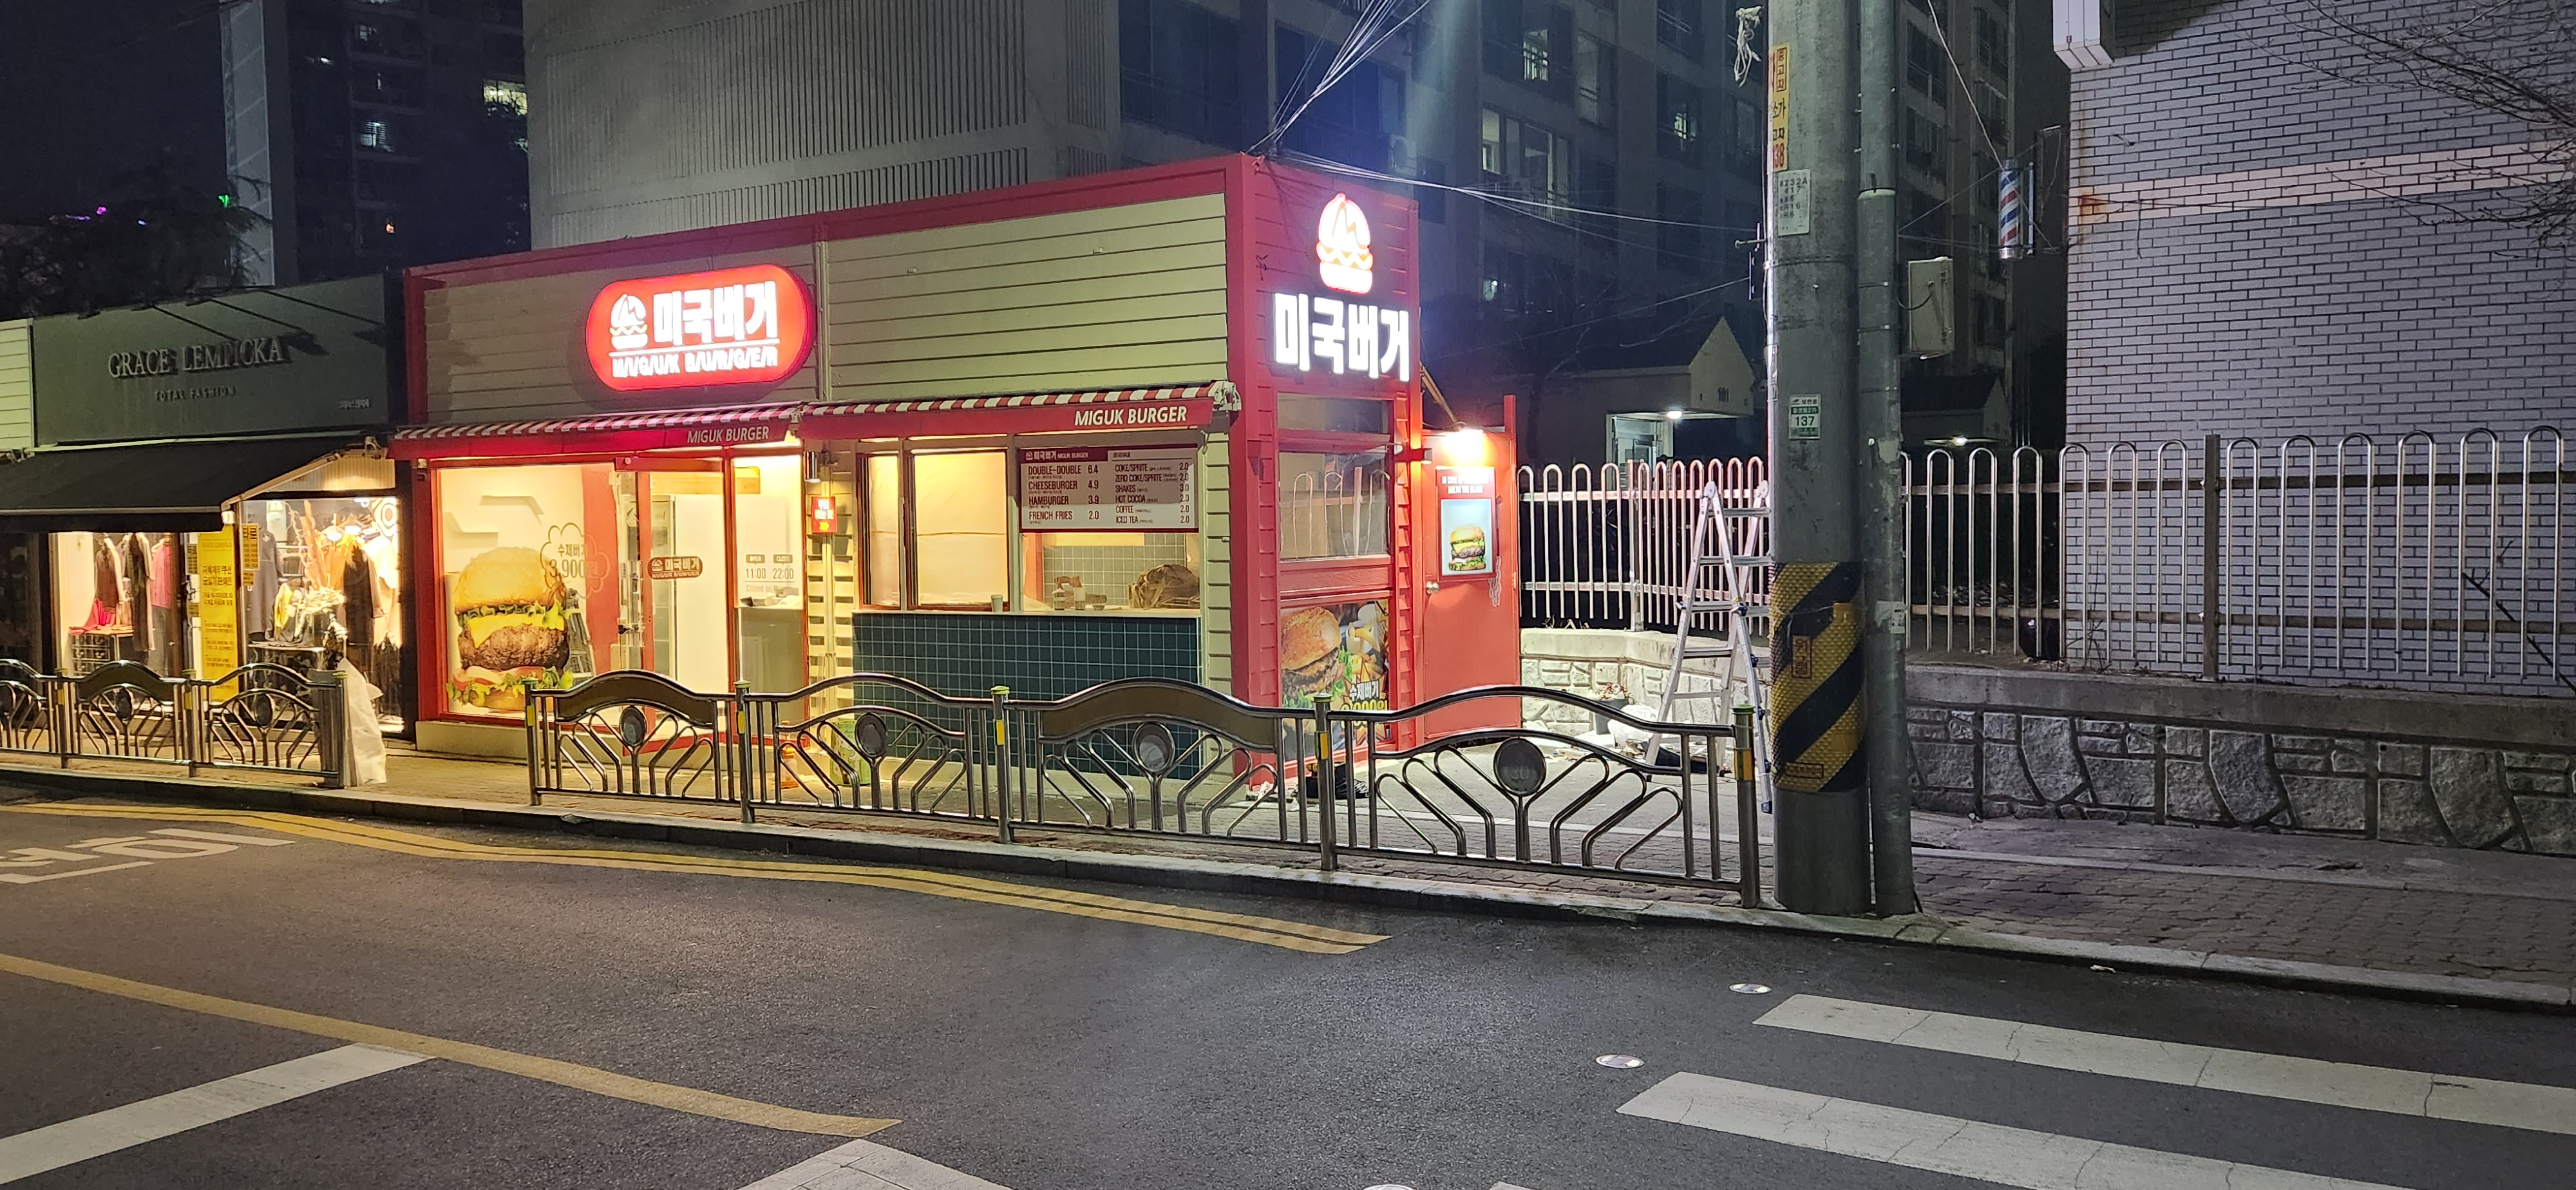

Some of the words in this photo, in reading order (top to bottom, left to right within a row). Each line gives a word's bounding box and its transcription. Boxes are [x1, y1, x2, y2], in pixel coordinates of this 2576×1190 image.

[653, 280, 778, 346] 미국버거
[1274, 292, 1410, 382] 미국버거
[108, 348, 171, 378] GRACE
[181, 337, 283, 371] LEMPICKA
[155, 389, 185, 402] TOTAL
[190, 386, 235, 399] FASHION
[1074, 409, 1124, 426] MIGUK
[1127, 406, 1187, 424] BURGER
[1795, 416, 1815, 426] 137
[687, 429, 723, 444] MIGUK
[726, 426, 769, 442] BURGER
[1034, 451, 1057, 460] 미국버거
[1028, 464, 1082, 475] DOUBLE-DOUBLE
[1087, 464, 1099, 474] 6.4
[1115, 464, 1148, 472] COKE/SPRITE
[1179, 462, 1189, 471] 2.0
[1028, 480, 1078, 490] CHEESEBURGER
[1088, 480, 1099, 489] 4.9
[1115, 484, 1136, 493] SHAKES
[1028, 495, 1069, 505] HAMBURGER
[1088, 495, 1099, 504] 3.9
[1127, 495, 1146, 503] COCOA
[1115, 505, 1134, 513] COFFEE
[1180, 504, 1189, 513] 2.0
[1028, 511, 1054, 520] FRENCH
[1055, 511, 1073, 520] FRIES
[1088, 510, 1099, 520] 2.0
[1180, 515, 1190, 524] 2.0
[558, 543, 589, 558] 수제버거
[665, 558, 699, 571] 미국버거
[746, 568, 766, 579] 11:00
[773, 568, 794, 579] 22:00
[1349, 680, 1379, 702] 수제버거
